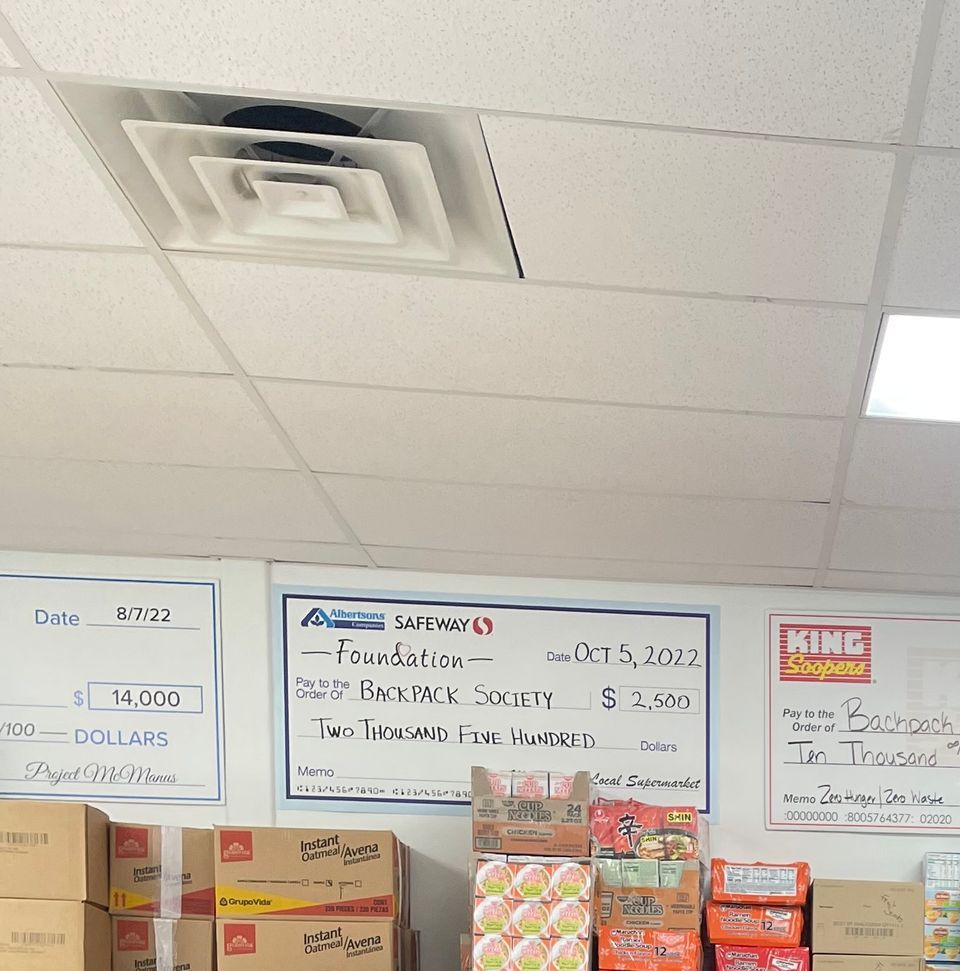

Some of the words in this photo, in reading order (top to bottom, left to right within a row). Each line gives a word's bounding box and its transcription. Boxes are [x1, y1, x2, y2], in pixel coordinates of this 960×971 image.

[35, 609, 80, 626] Date
[116, 607, 171, 622] 8/7/22
[329, 608, 385, 621] Albertsons
[395, 615, 470, 632] SAFEWAY
[786, 630, 864, 656] KING
[547, 651, 571, 663] Date
[619, 643, 637, 669] 5,
[643, 645, 702, 668] 2022
[785, 653, 865, 681] Soopers
[296, 677, 316, 689] Pay
[319, 678, 330, 688] to
[333, 678, 350, 689] the
[73, 690, 84, 707] $
[112, 689, 181, 709] 14,000
[296, 689, 327, 700] Order
[330, 689, 344, 700] Of
[360, 679, 459, 705] BACKPACK
[475, 684, 553, 709] SOCIETY
[602, 685, 616, 711] $
[631, 691, 691, 711] 2,500
[782, 708, 802, 720] Pay
[804, 709, 815, 719] to
[817, 709, 835, 719] the
[792, 722, 823, 733] Order
[824, 722, 836, 733] of
[75, 728, 169, 748] DOLLARS
[511, 727, 596, 749] HUNDRED
[640, 740, 678, 753] Dollars
[787, 741, 827, 765] Ten
[838, 740, 938, 766] Thousand
[25, 761, 81, 787] Project
[83, 763, 178, 785] McManus
[297, 766, 335, 778] Memo
[625, 774, 701, 790] Supermarket
[783, 793, 816, 804] Memo
[567, 803, 582, 813] 24
[667, 813, 692, 822] SHIN
[617, 812, 643, 848] 辛
[300, 834, 341, 853] Instant
[761, 921, 773, 931] 12
[303, 926, 342, 946] Instant
[654, 946, 667, 957] 12
